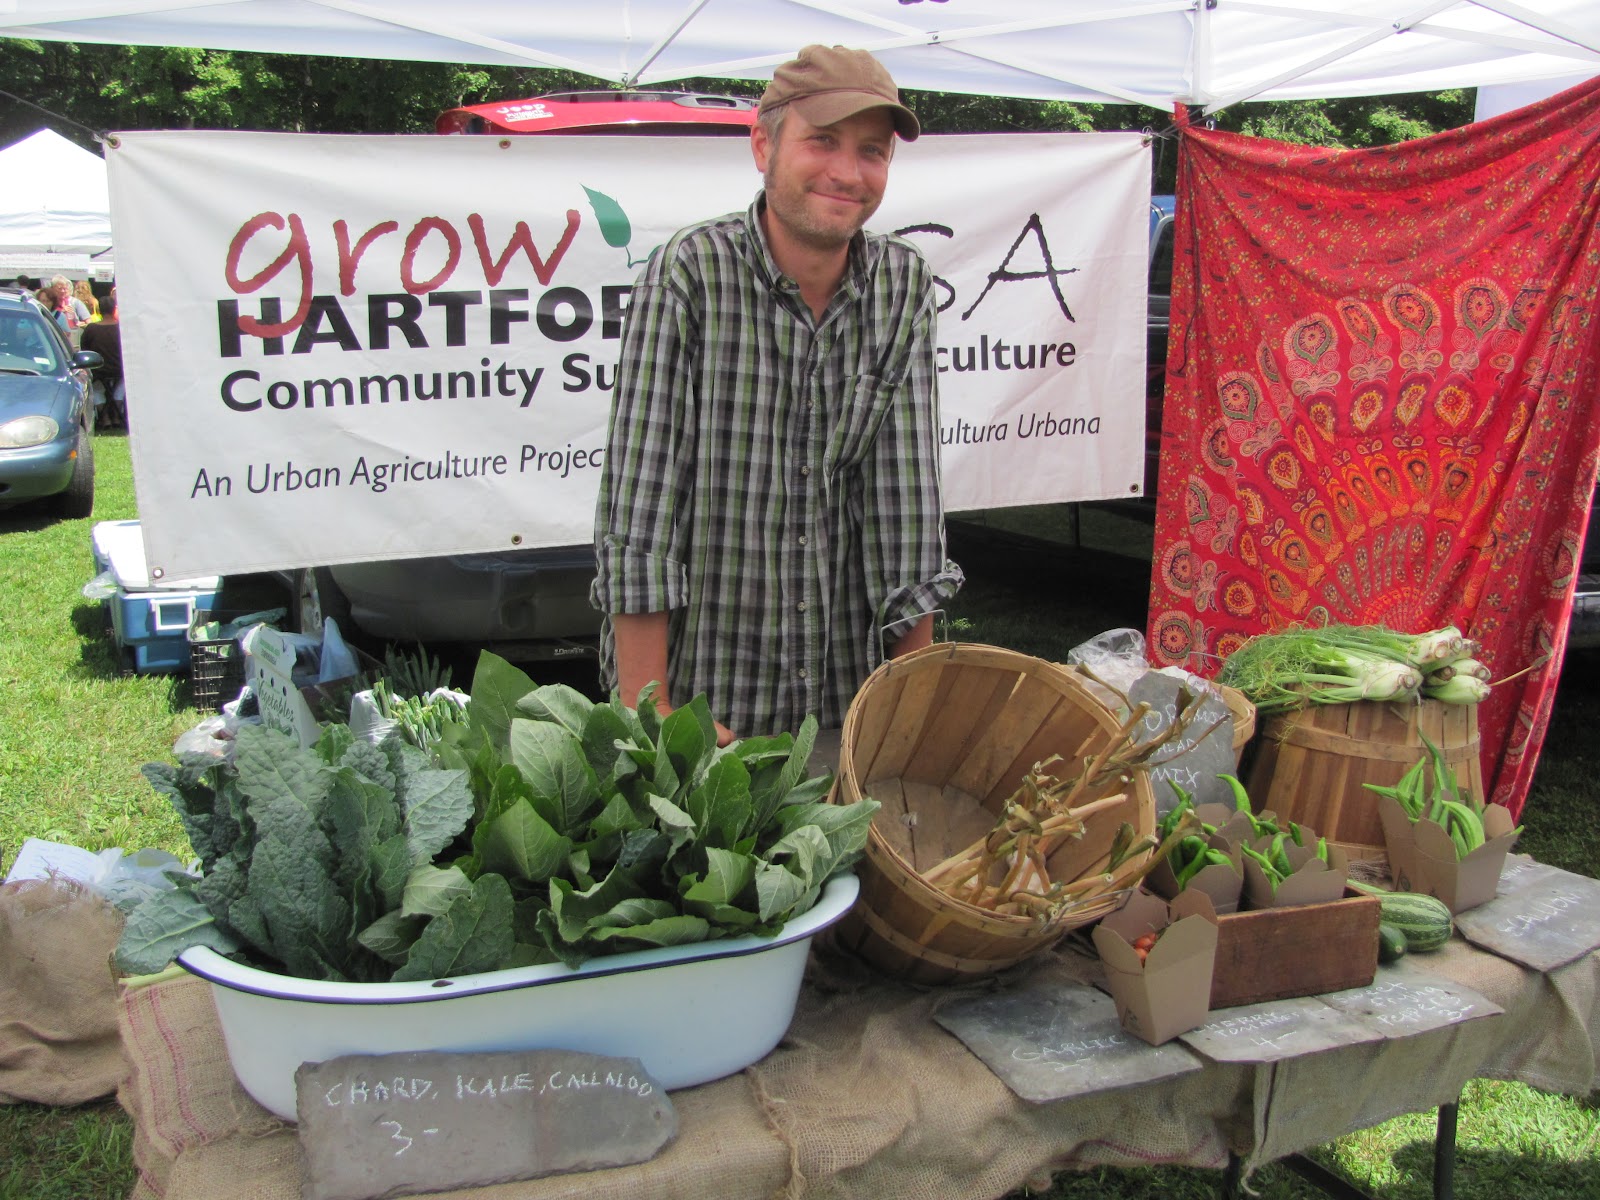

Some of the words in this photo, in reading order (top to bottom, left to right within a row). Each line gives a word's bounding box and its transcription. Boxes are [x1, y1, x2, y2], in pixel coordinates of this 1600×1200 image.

[225, 209, 581, 338] grow
[217, 285, 633, 358] HARTFOR
[221, 358, 545, 413] Community
[940, 418, 1008, 446] ultura
[1016, 412, 1101, 439] Urbana
[190, 467, 232, 499] An
[246, 463, 341, 494] Urban
[349, 450, 508, 493] Agriculture
[519, 442, 606, 479] Projec
[1150, 766, 1201, 788] MIX
